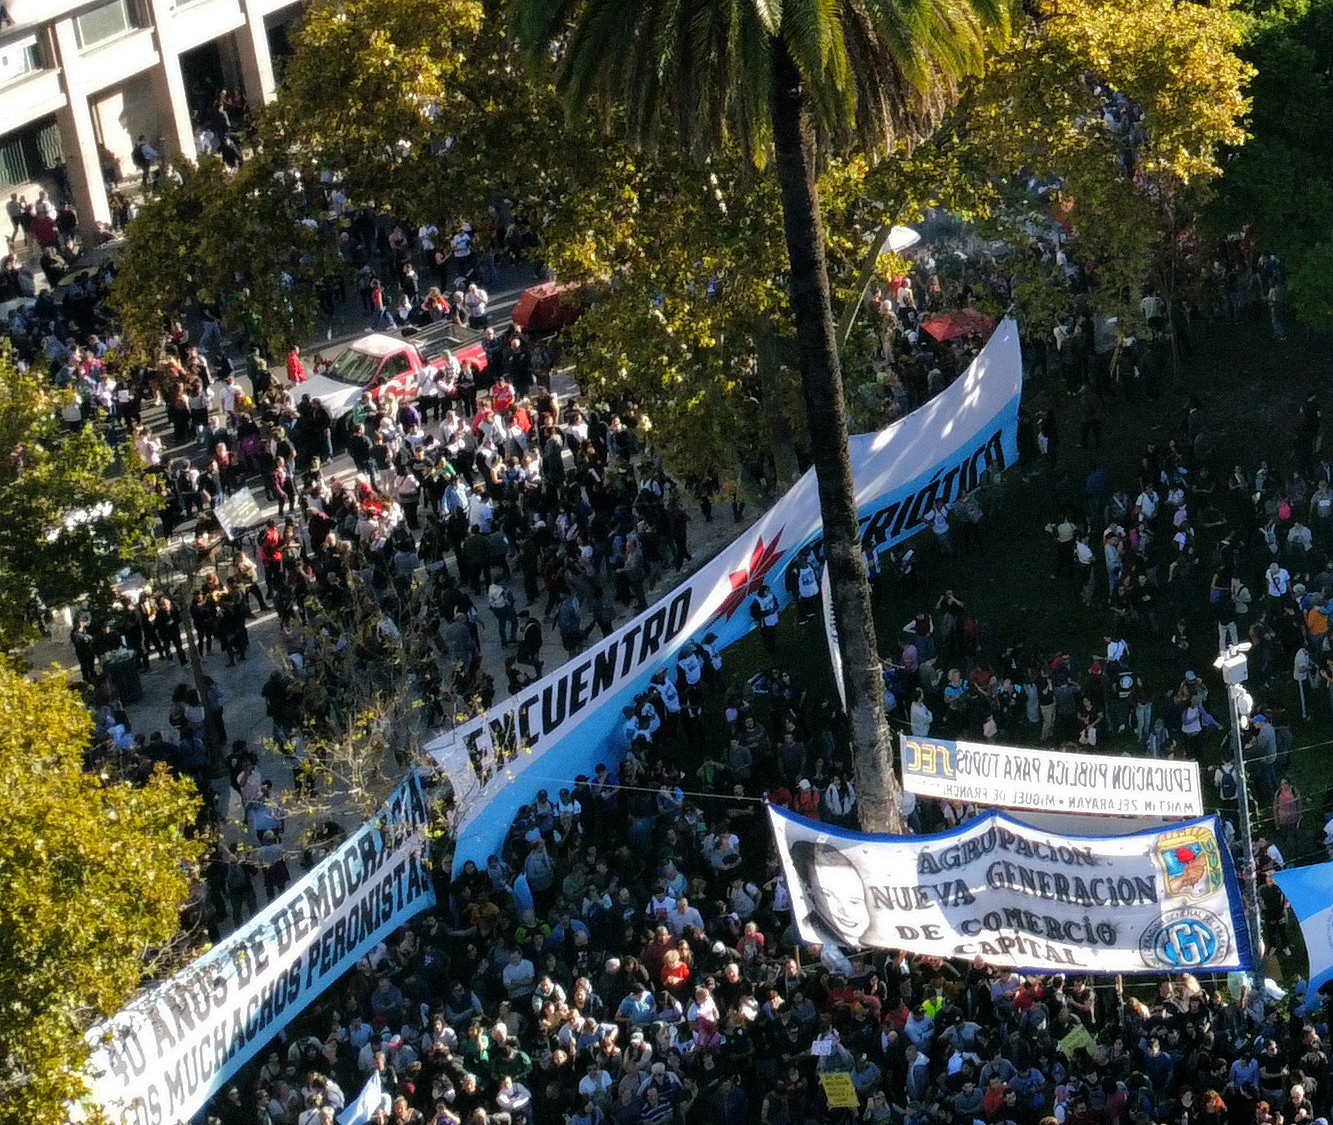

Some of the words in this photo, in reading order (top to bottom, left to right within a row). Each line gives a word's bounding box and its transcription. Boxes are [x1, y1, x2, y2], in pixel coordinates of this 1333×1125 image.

[860, 431, 1007, 552] RIÓTICO
[463, 586, 694, 791] ENCUENTRO
[869, 878, 977, 911] NUEVA
[894, 923, 945, 942] DE
[1155, 923, 1212, 966] CGT
[228, 938, 271, 990] DE
[168, 964, 299, 1116] MUCHACHOS
